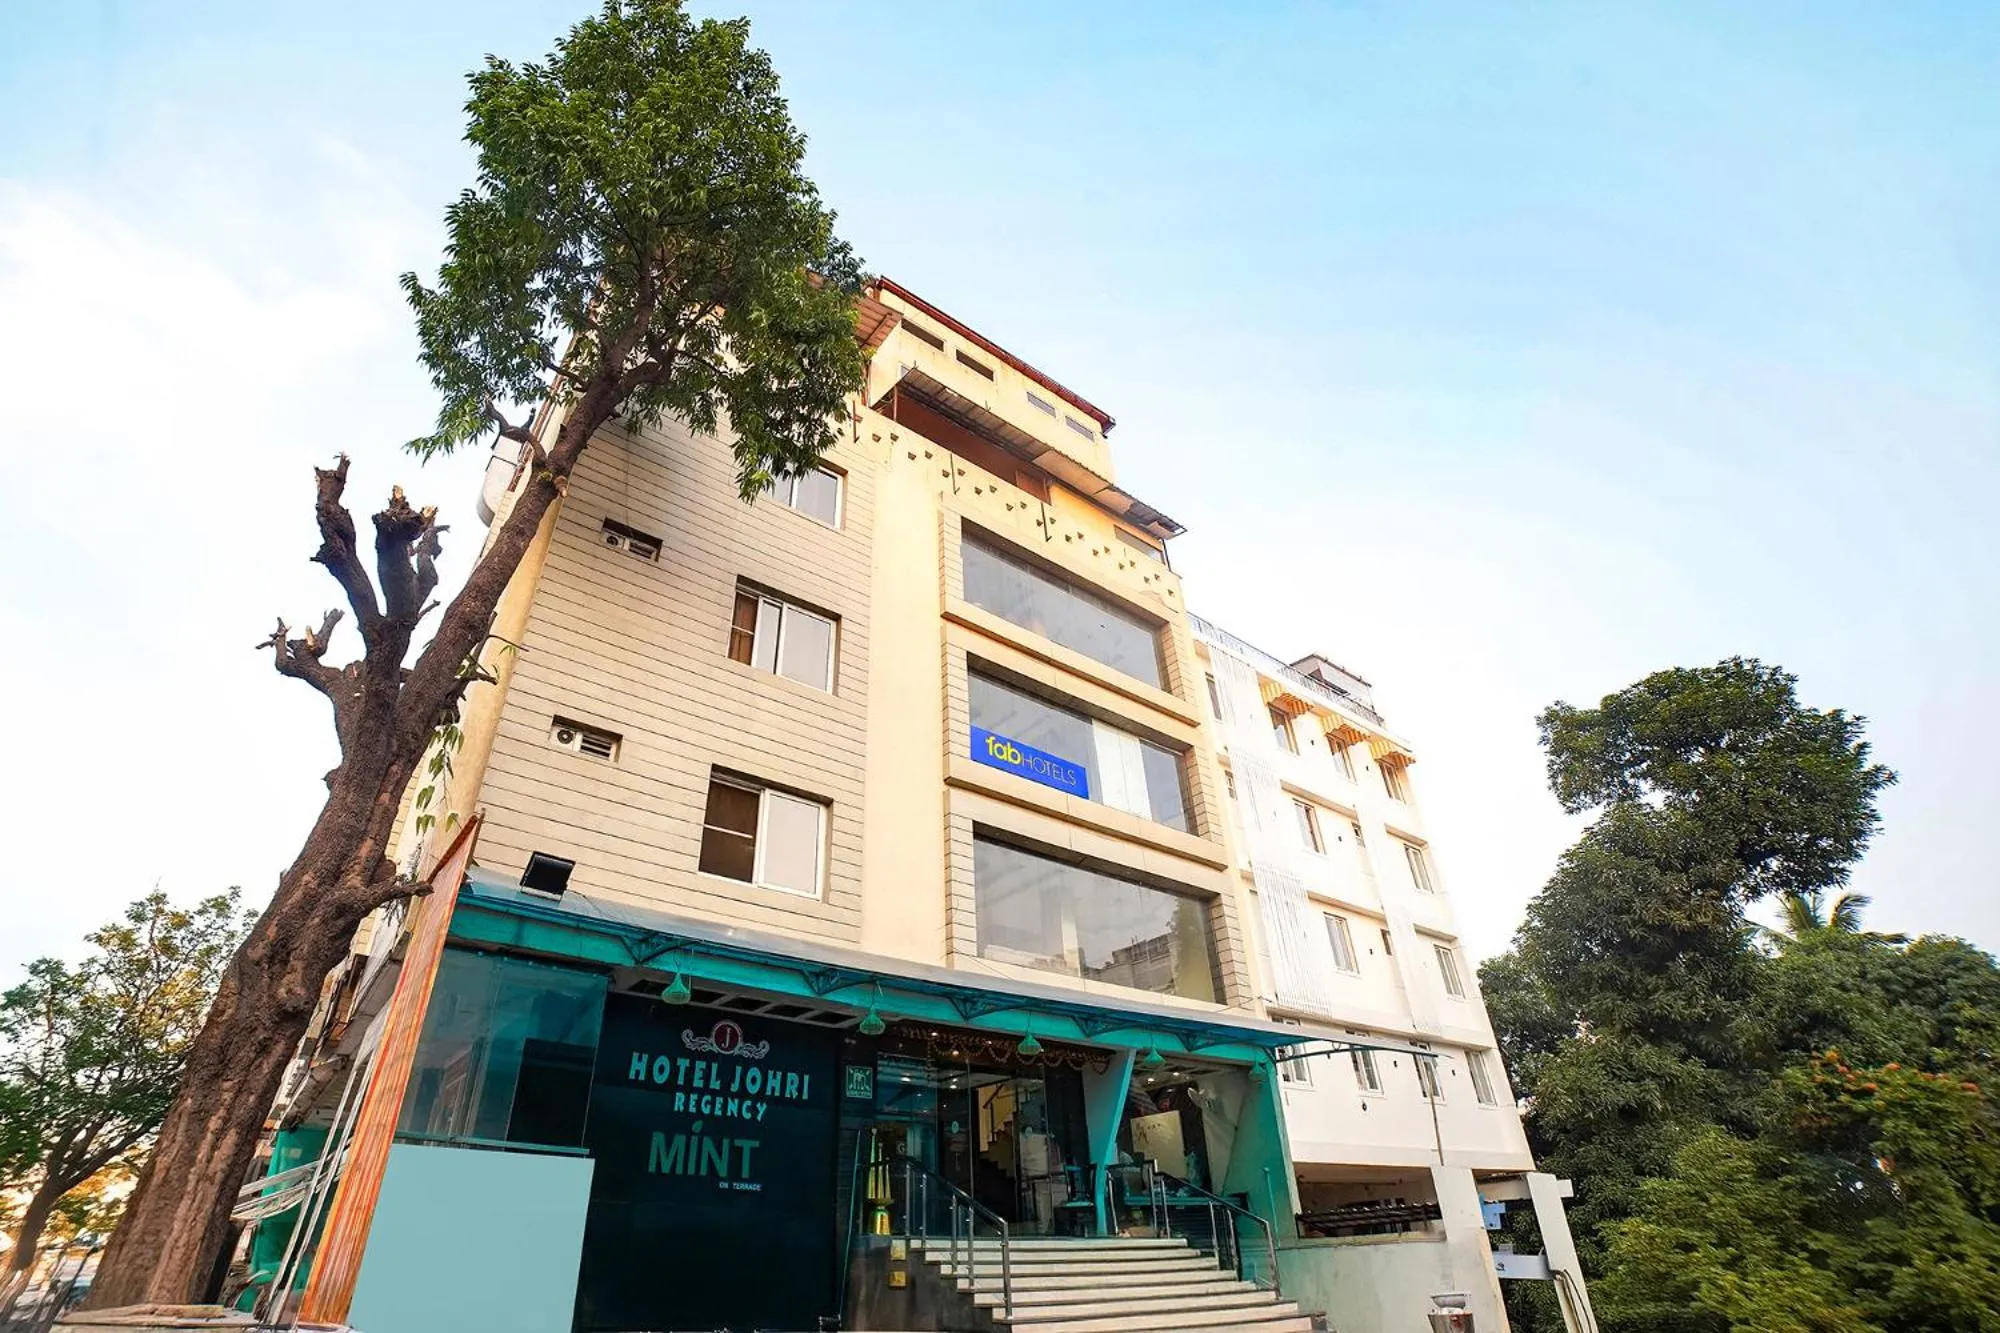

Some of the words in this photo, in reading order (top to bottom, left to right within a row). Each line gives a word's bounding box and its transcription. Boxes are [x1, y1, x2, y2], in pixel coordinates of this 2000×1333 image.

[628, 1052, 720, 1090] HOTEL
[730, 1066, 810, 1100] JOHRI
[673, 1092, 767, 1122] REGENCY
